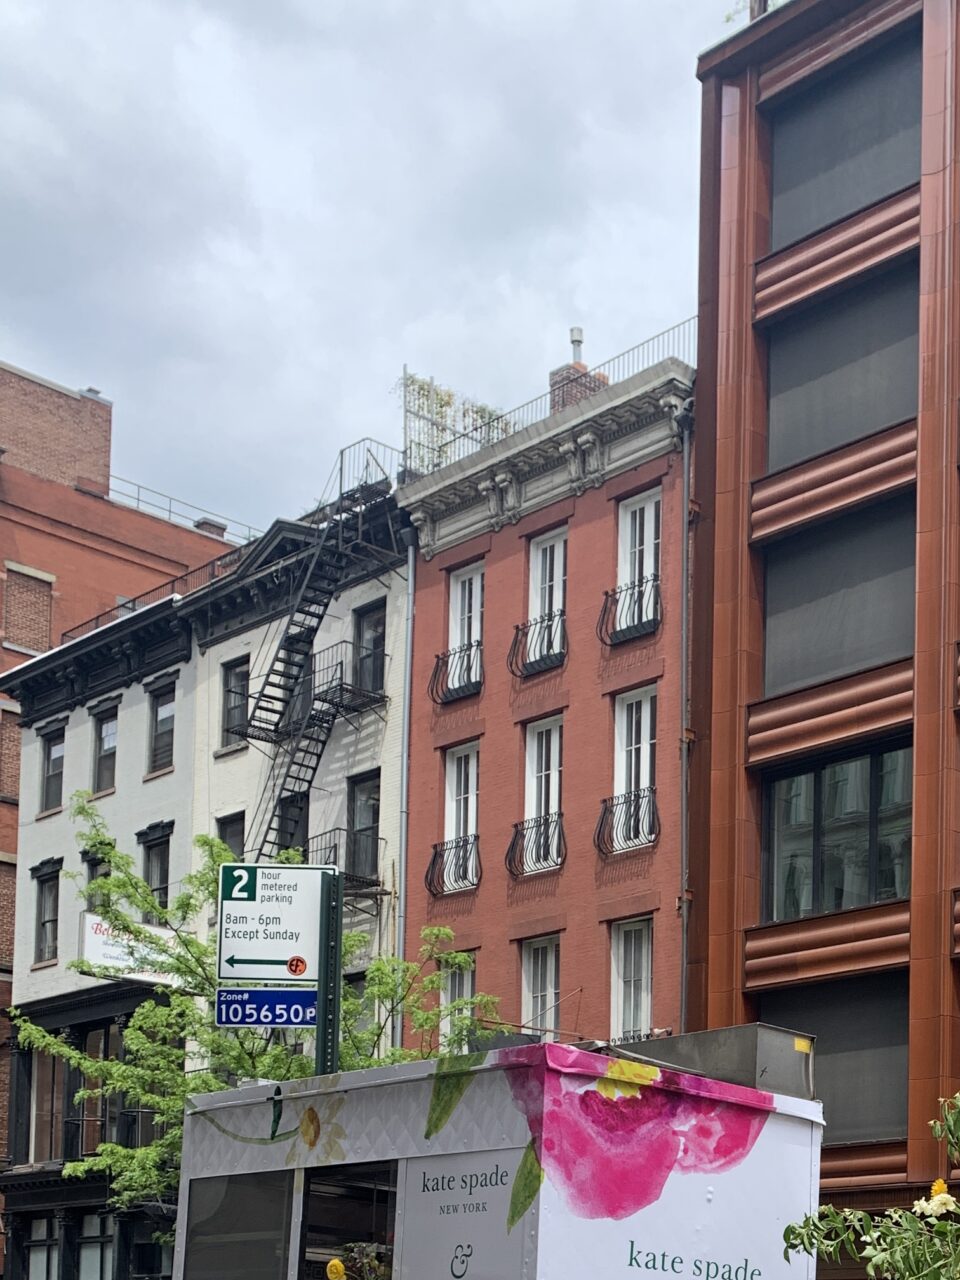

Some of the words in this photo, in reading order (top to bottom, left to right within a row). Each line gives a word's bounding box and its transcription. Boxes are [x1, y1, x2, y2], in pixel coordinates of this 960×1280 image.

[261, 870, 281, 880] hour
[231, 869, 249, 898] 2
[261, 882, 298, 892] metered
[260, 893, 293, 905] parking
[225, 914, 248, 925] 8am
[258, 914, 281, 927] 6pm
[224, 928, 259, 941] Except
[263, 929, 300, 942] Sunday
[220, 993, 249, 1001] Zone#
[220, 1004, 303, 1023] 105650
[421, 1171, 456, 1193] kate
[460, 1164, 509, 1195] spade
[439, 1204, 459, 1215] NEW
[462, 1201, 488, 1213] YORK
[450, 1244, 473, 1279] &
[628, 1240, 684, 1274] kate
